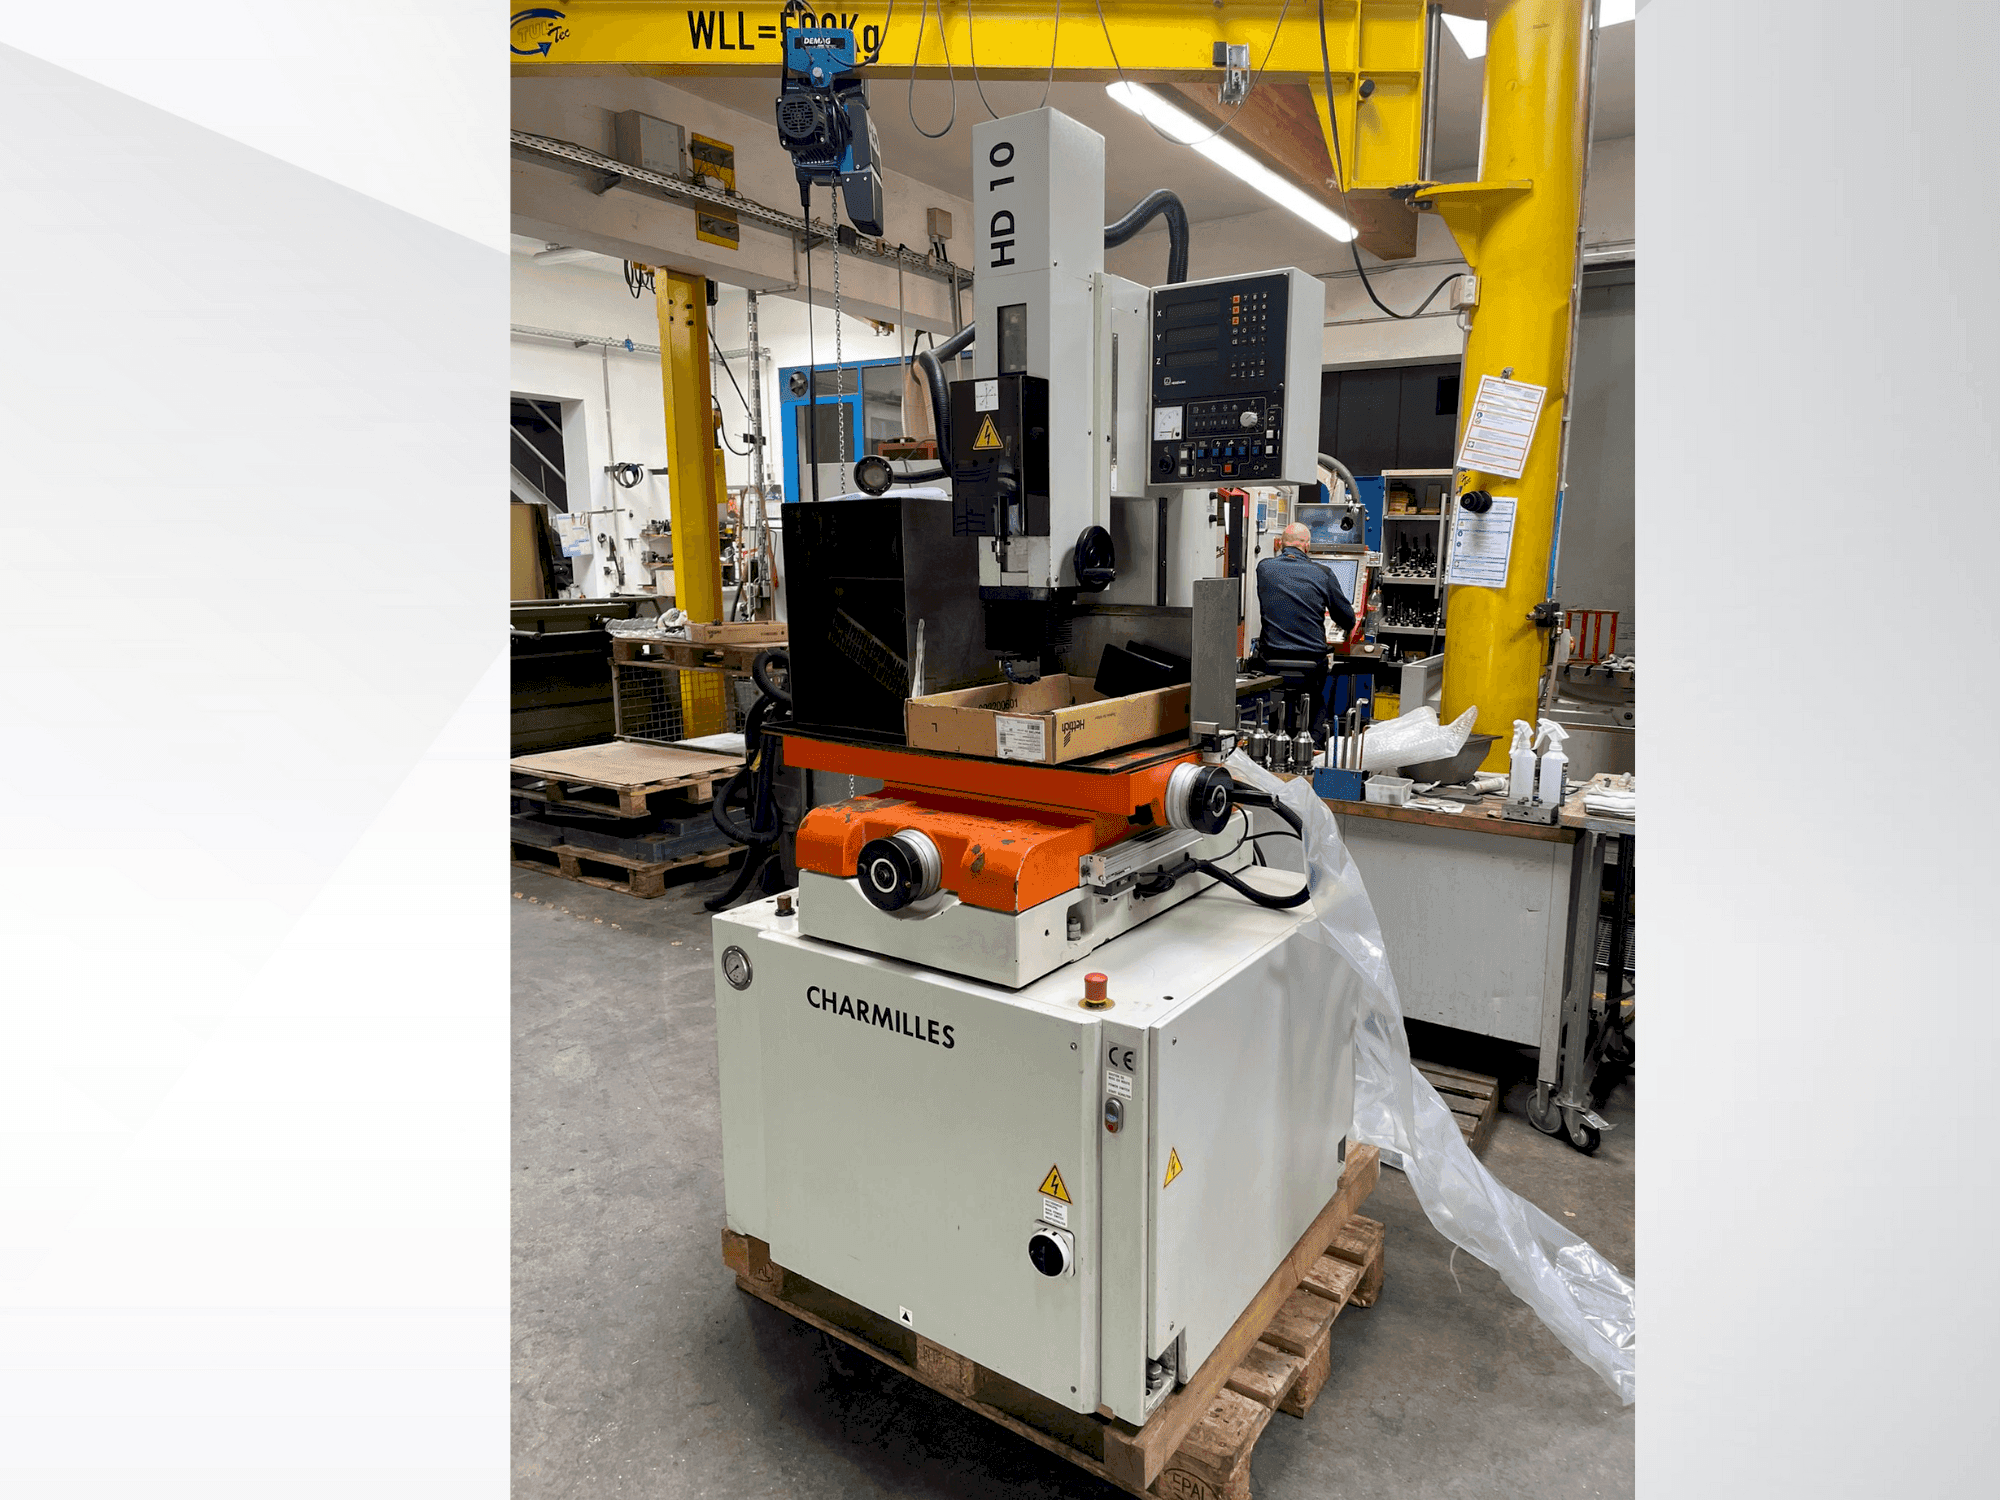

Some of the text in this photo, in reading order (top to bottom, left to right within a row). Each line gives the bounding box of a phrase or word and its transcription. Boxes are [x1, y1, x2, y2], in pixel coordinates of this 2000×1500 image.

[803, 37, 831, 45] DEMAG
[989, 142, 1015, 268] HD 10
[1156, 357, 1161, 365] Z
[806, 985, 955, 1049] CHARMILLES
[1108, 1046, 1134, 1072] CE
